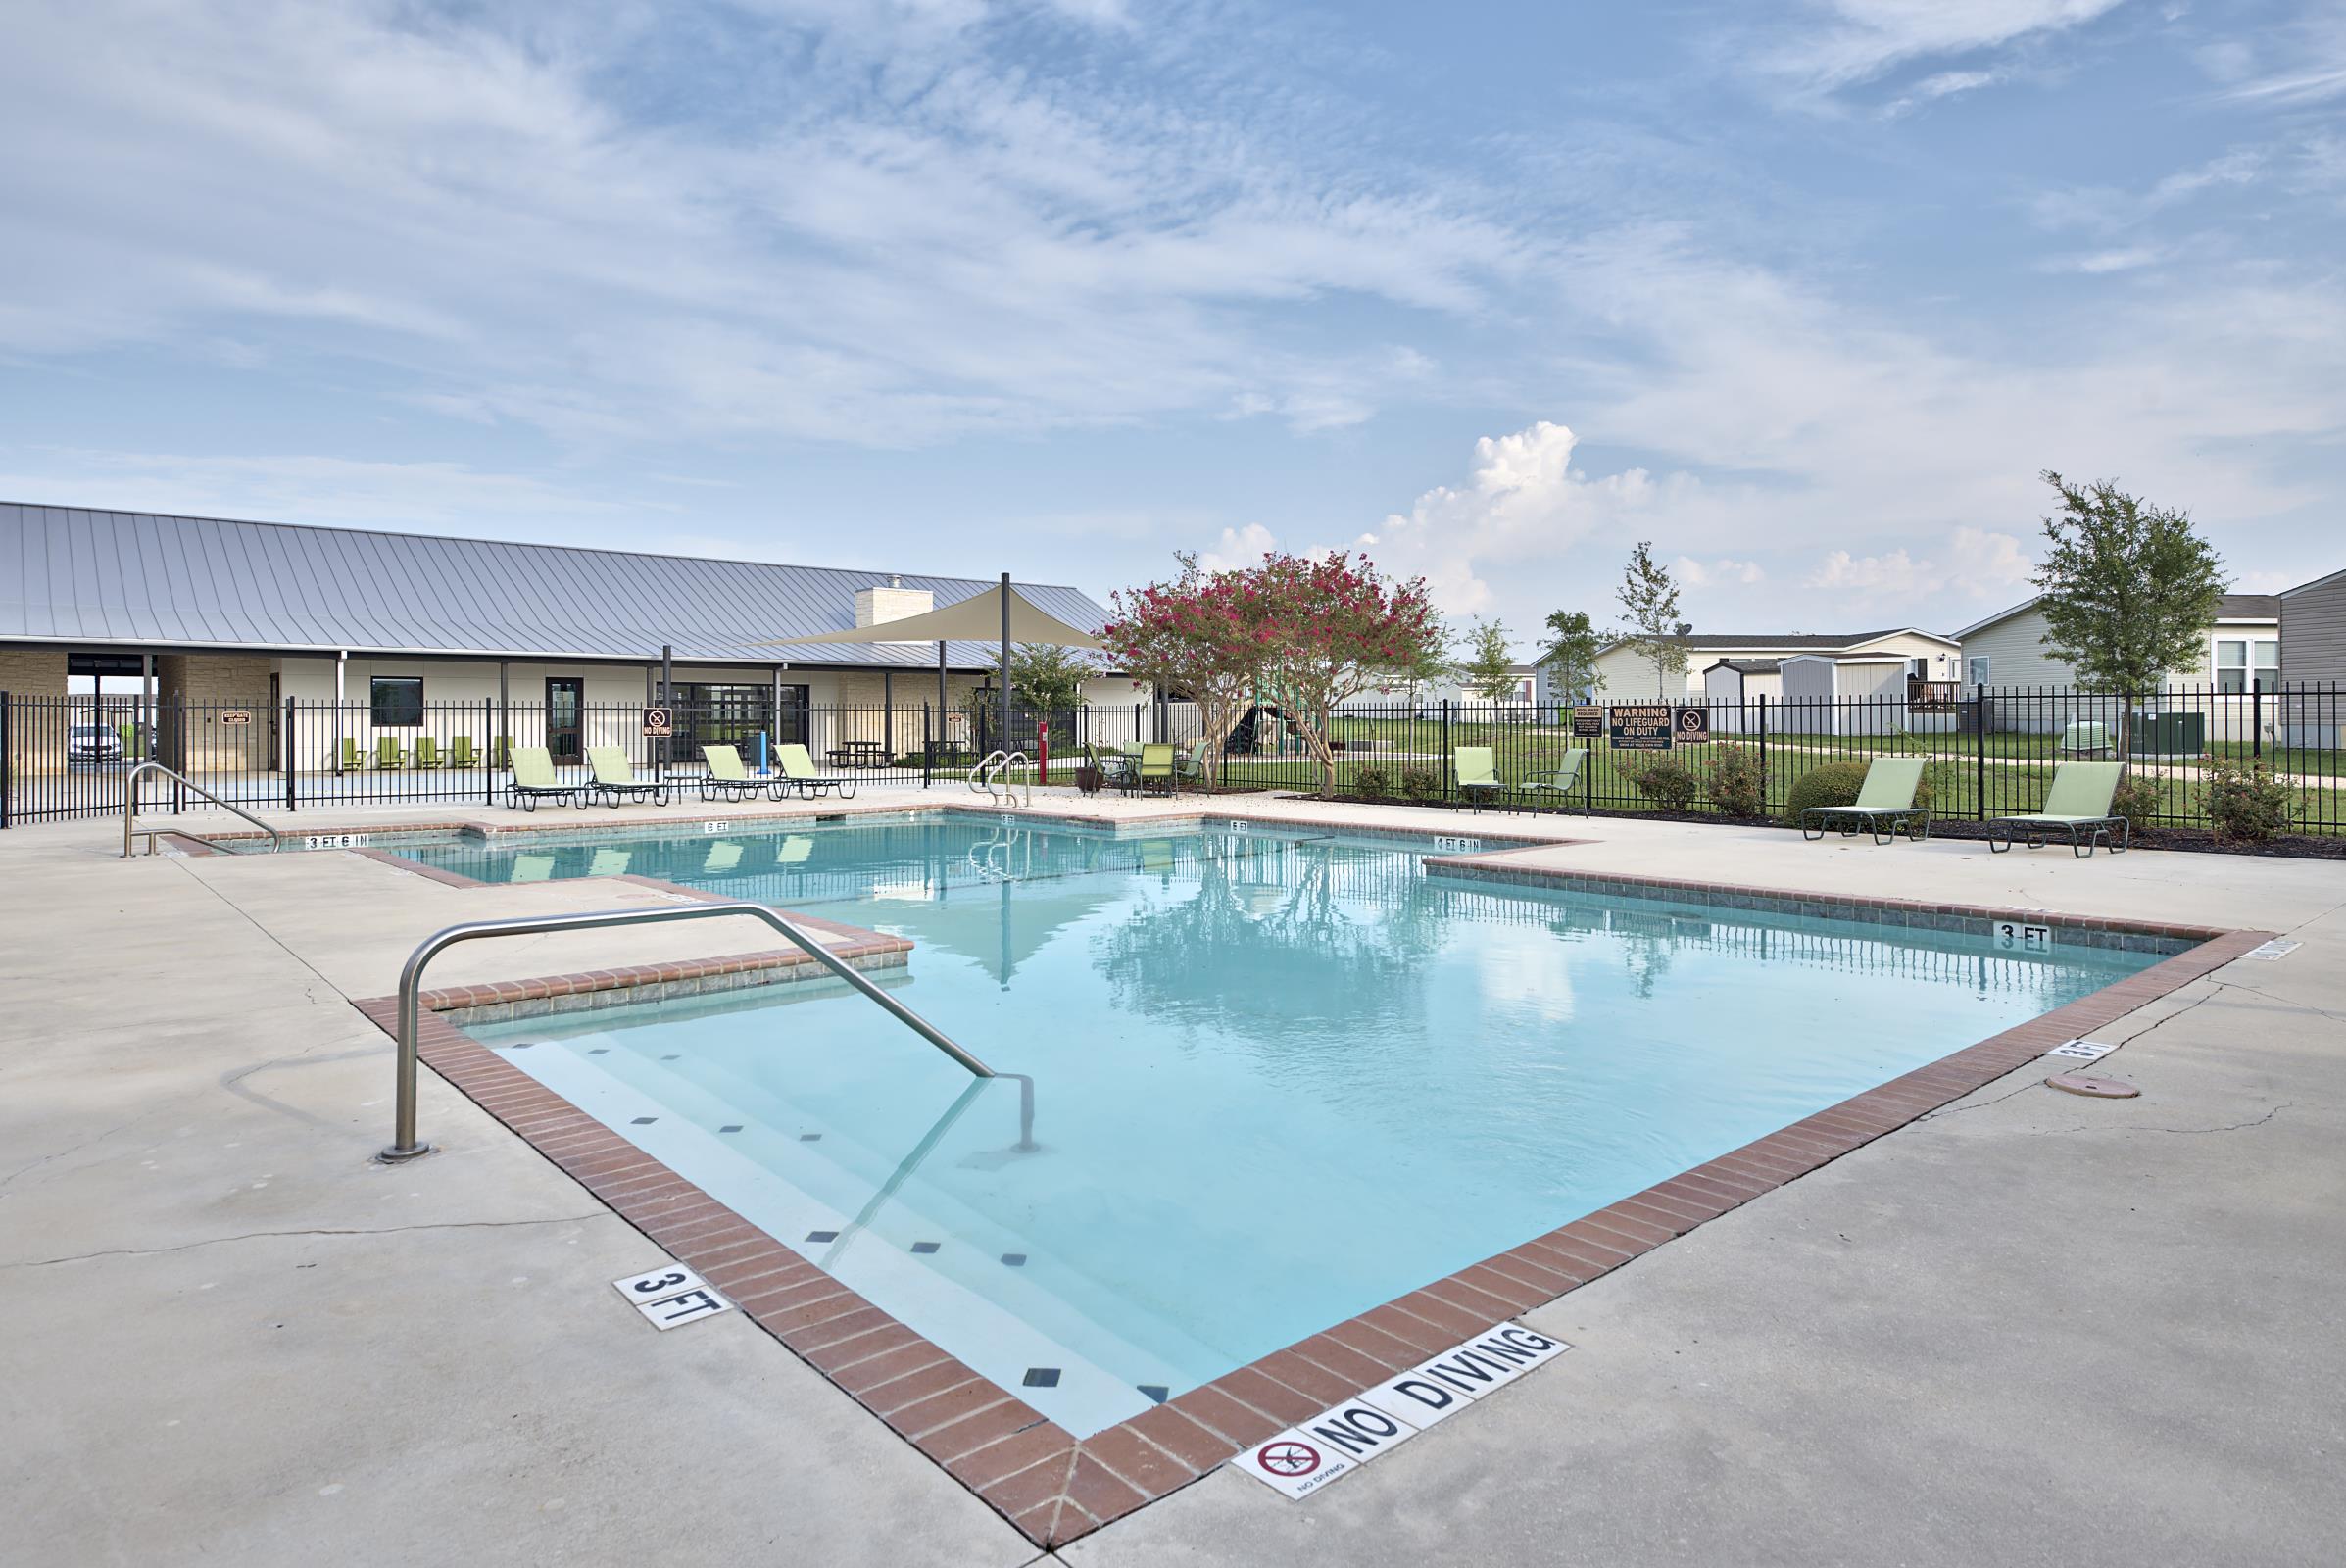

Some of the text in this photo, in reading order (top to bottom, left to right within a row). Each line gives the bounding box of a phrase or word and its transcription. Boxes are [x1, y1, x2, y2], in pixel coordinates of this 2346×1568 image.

[1613, 708, 1668, 717] WARNING
[1612, 717, 1670, 727] NO LIFEGUARD
[644, 726, 671, 735] NO DIVING
[1623, 726, 1659, 736] ON DUTY
[1677, 731, 1707, 741] NO DIVING
[2001, 924, 2015, 940] 3
[634, 1273, 722, 1321] 3 FT
[1312, 1328, 1557, 1454] NO DIVING
[1296, 1463, 1346, 1494] NO DIVING
